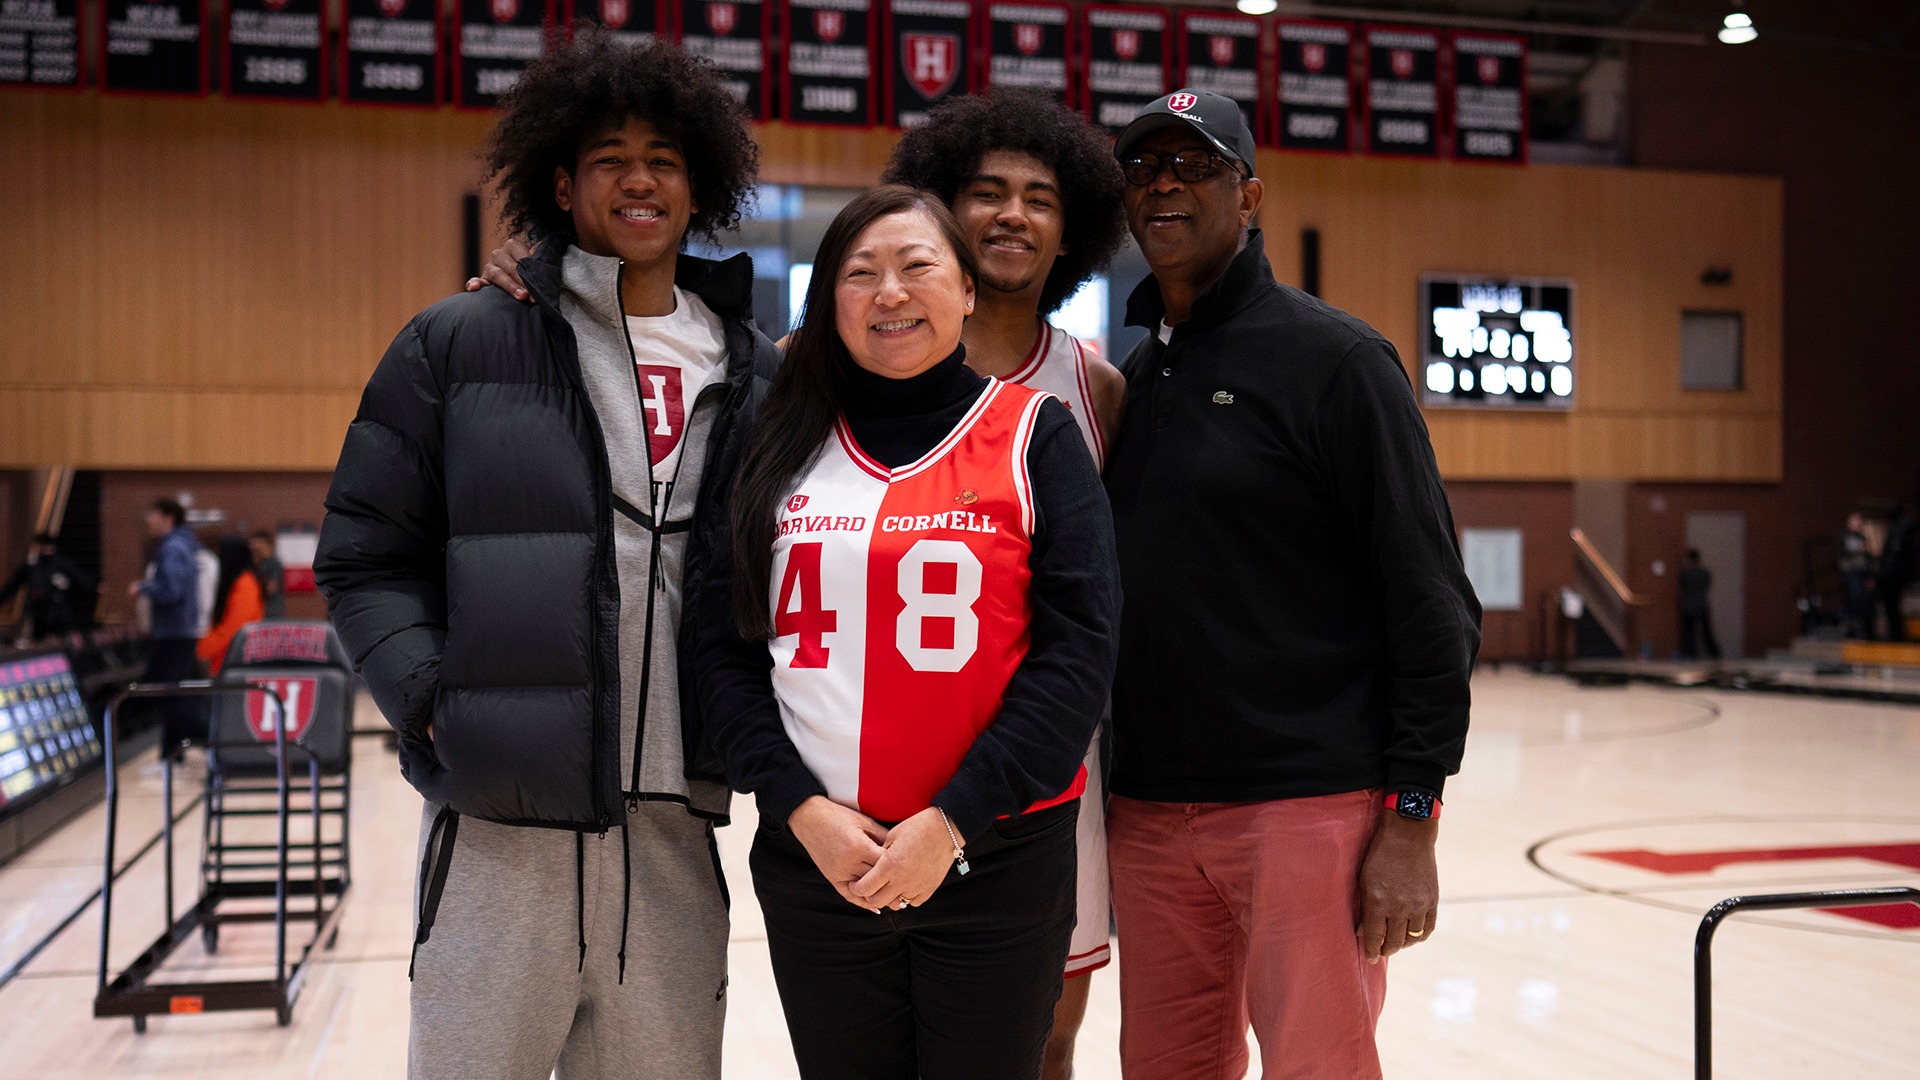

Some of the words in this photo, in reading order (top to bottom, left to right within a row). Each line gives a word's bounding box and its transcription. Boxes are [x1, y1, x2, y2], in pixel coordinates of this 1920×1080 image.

[913, 39, 948, 82] H
[1172, 95, 1192, 107] H
[790, 496, 805, 509] H
[881, 510, 997, 534] CORNELL
